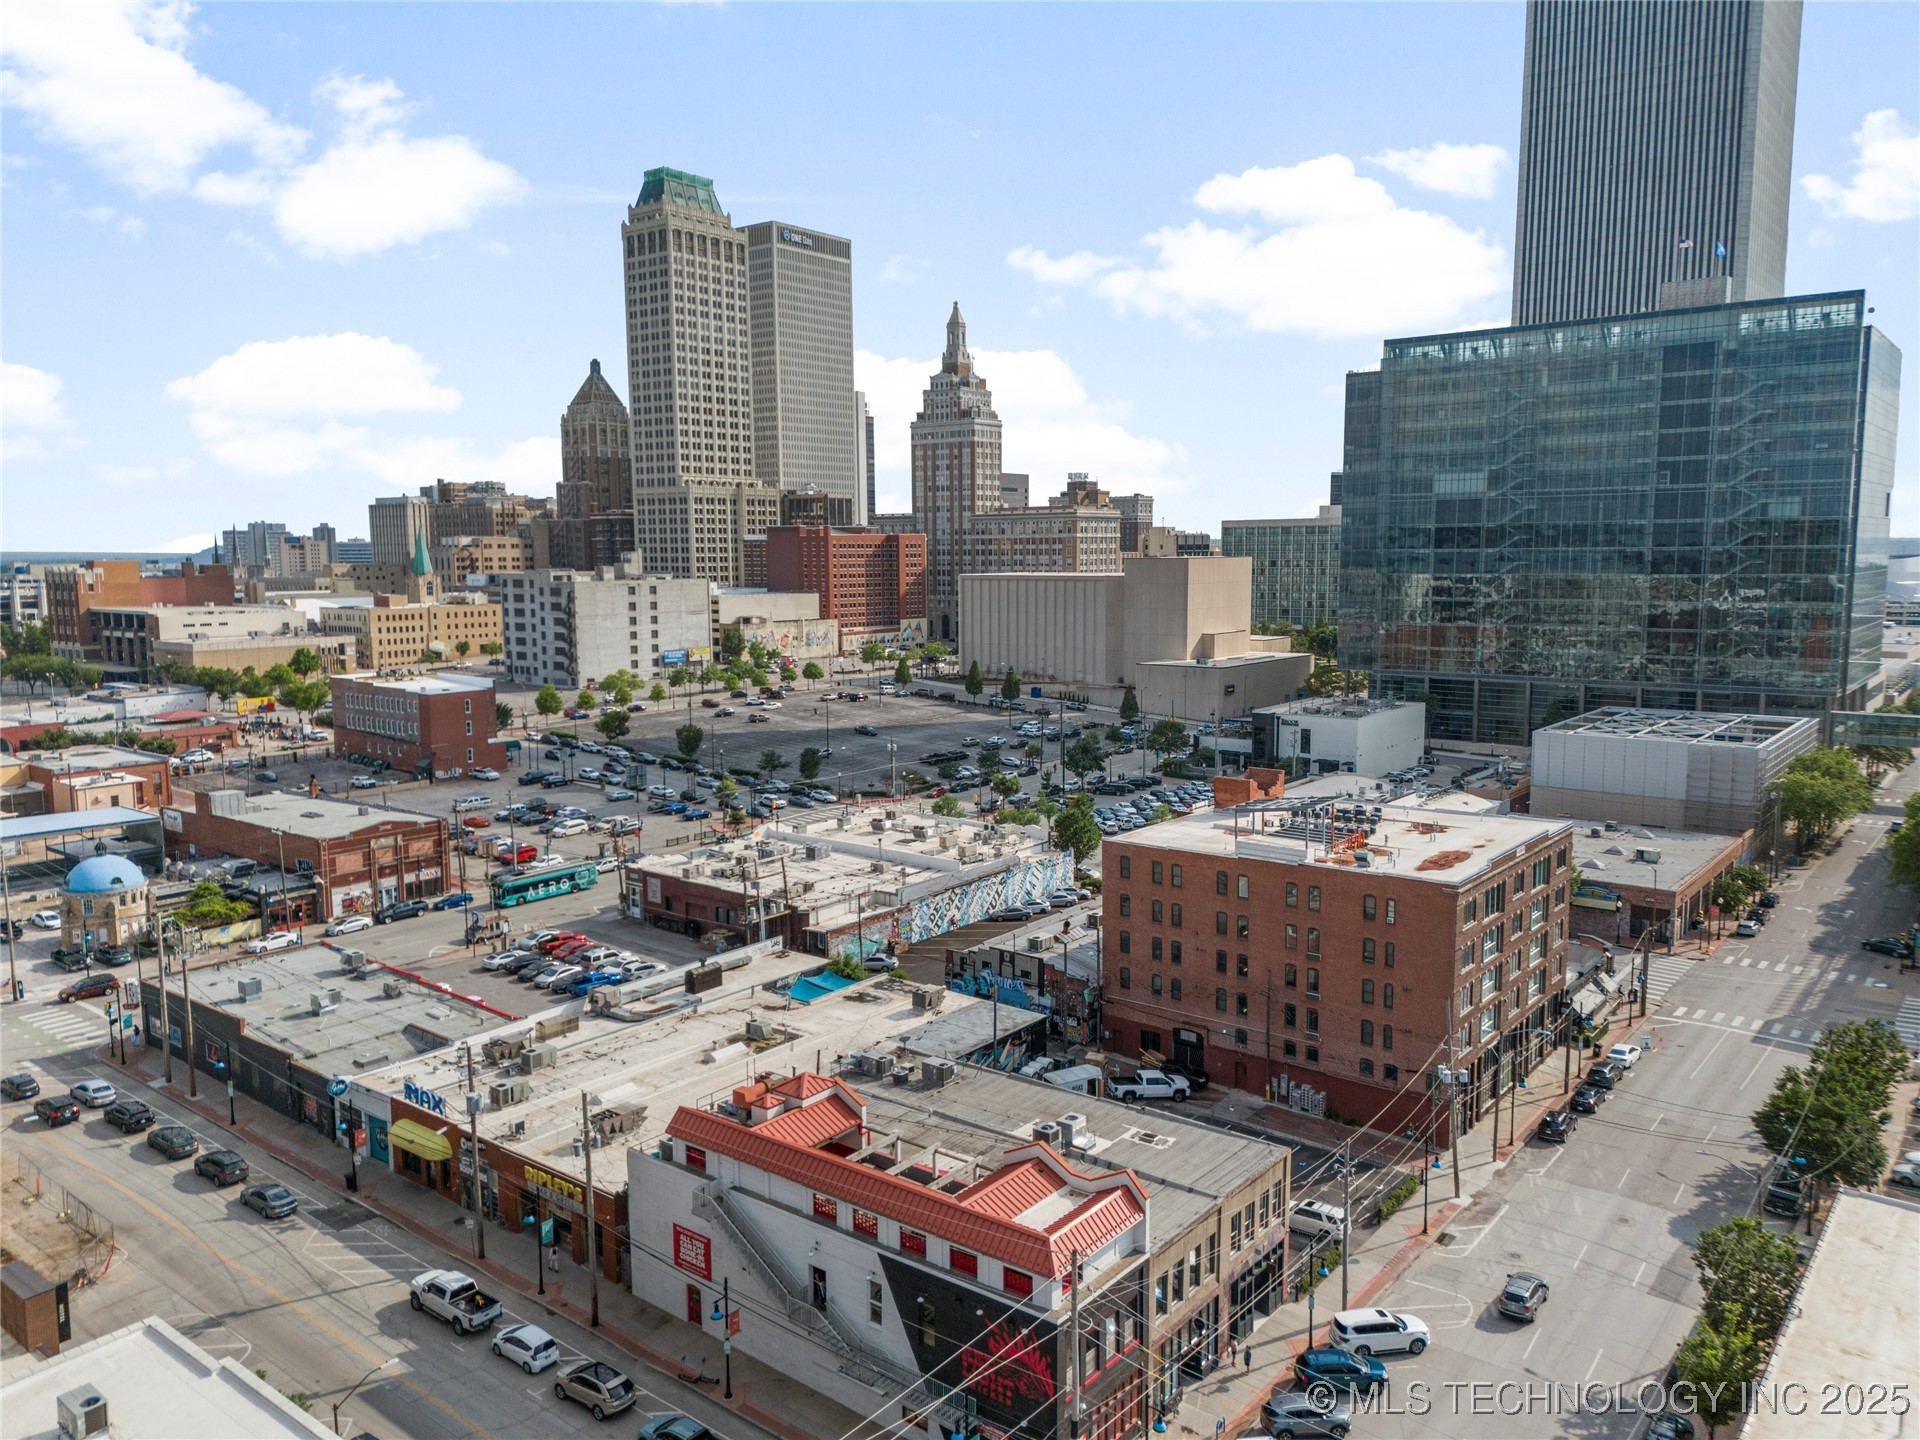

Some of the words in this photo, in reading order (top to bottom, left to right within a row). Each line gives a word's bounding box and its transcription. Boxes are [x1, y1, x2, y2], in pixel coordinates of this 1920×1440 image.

[527, 879, 569, 897] AERO
[404, 1082, 445, 1115] MAX
[524, 1165, 582, 1202] RIPLEY'S
[680, 1233, 692, 1244] ALL
[692, 1238, 705, 1248] YOU
